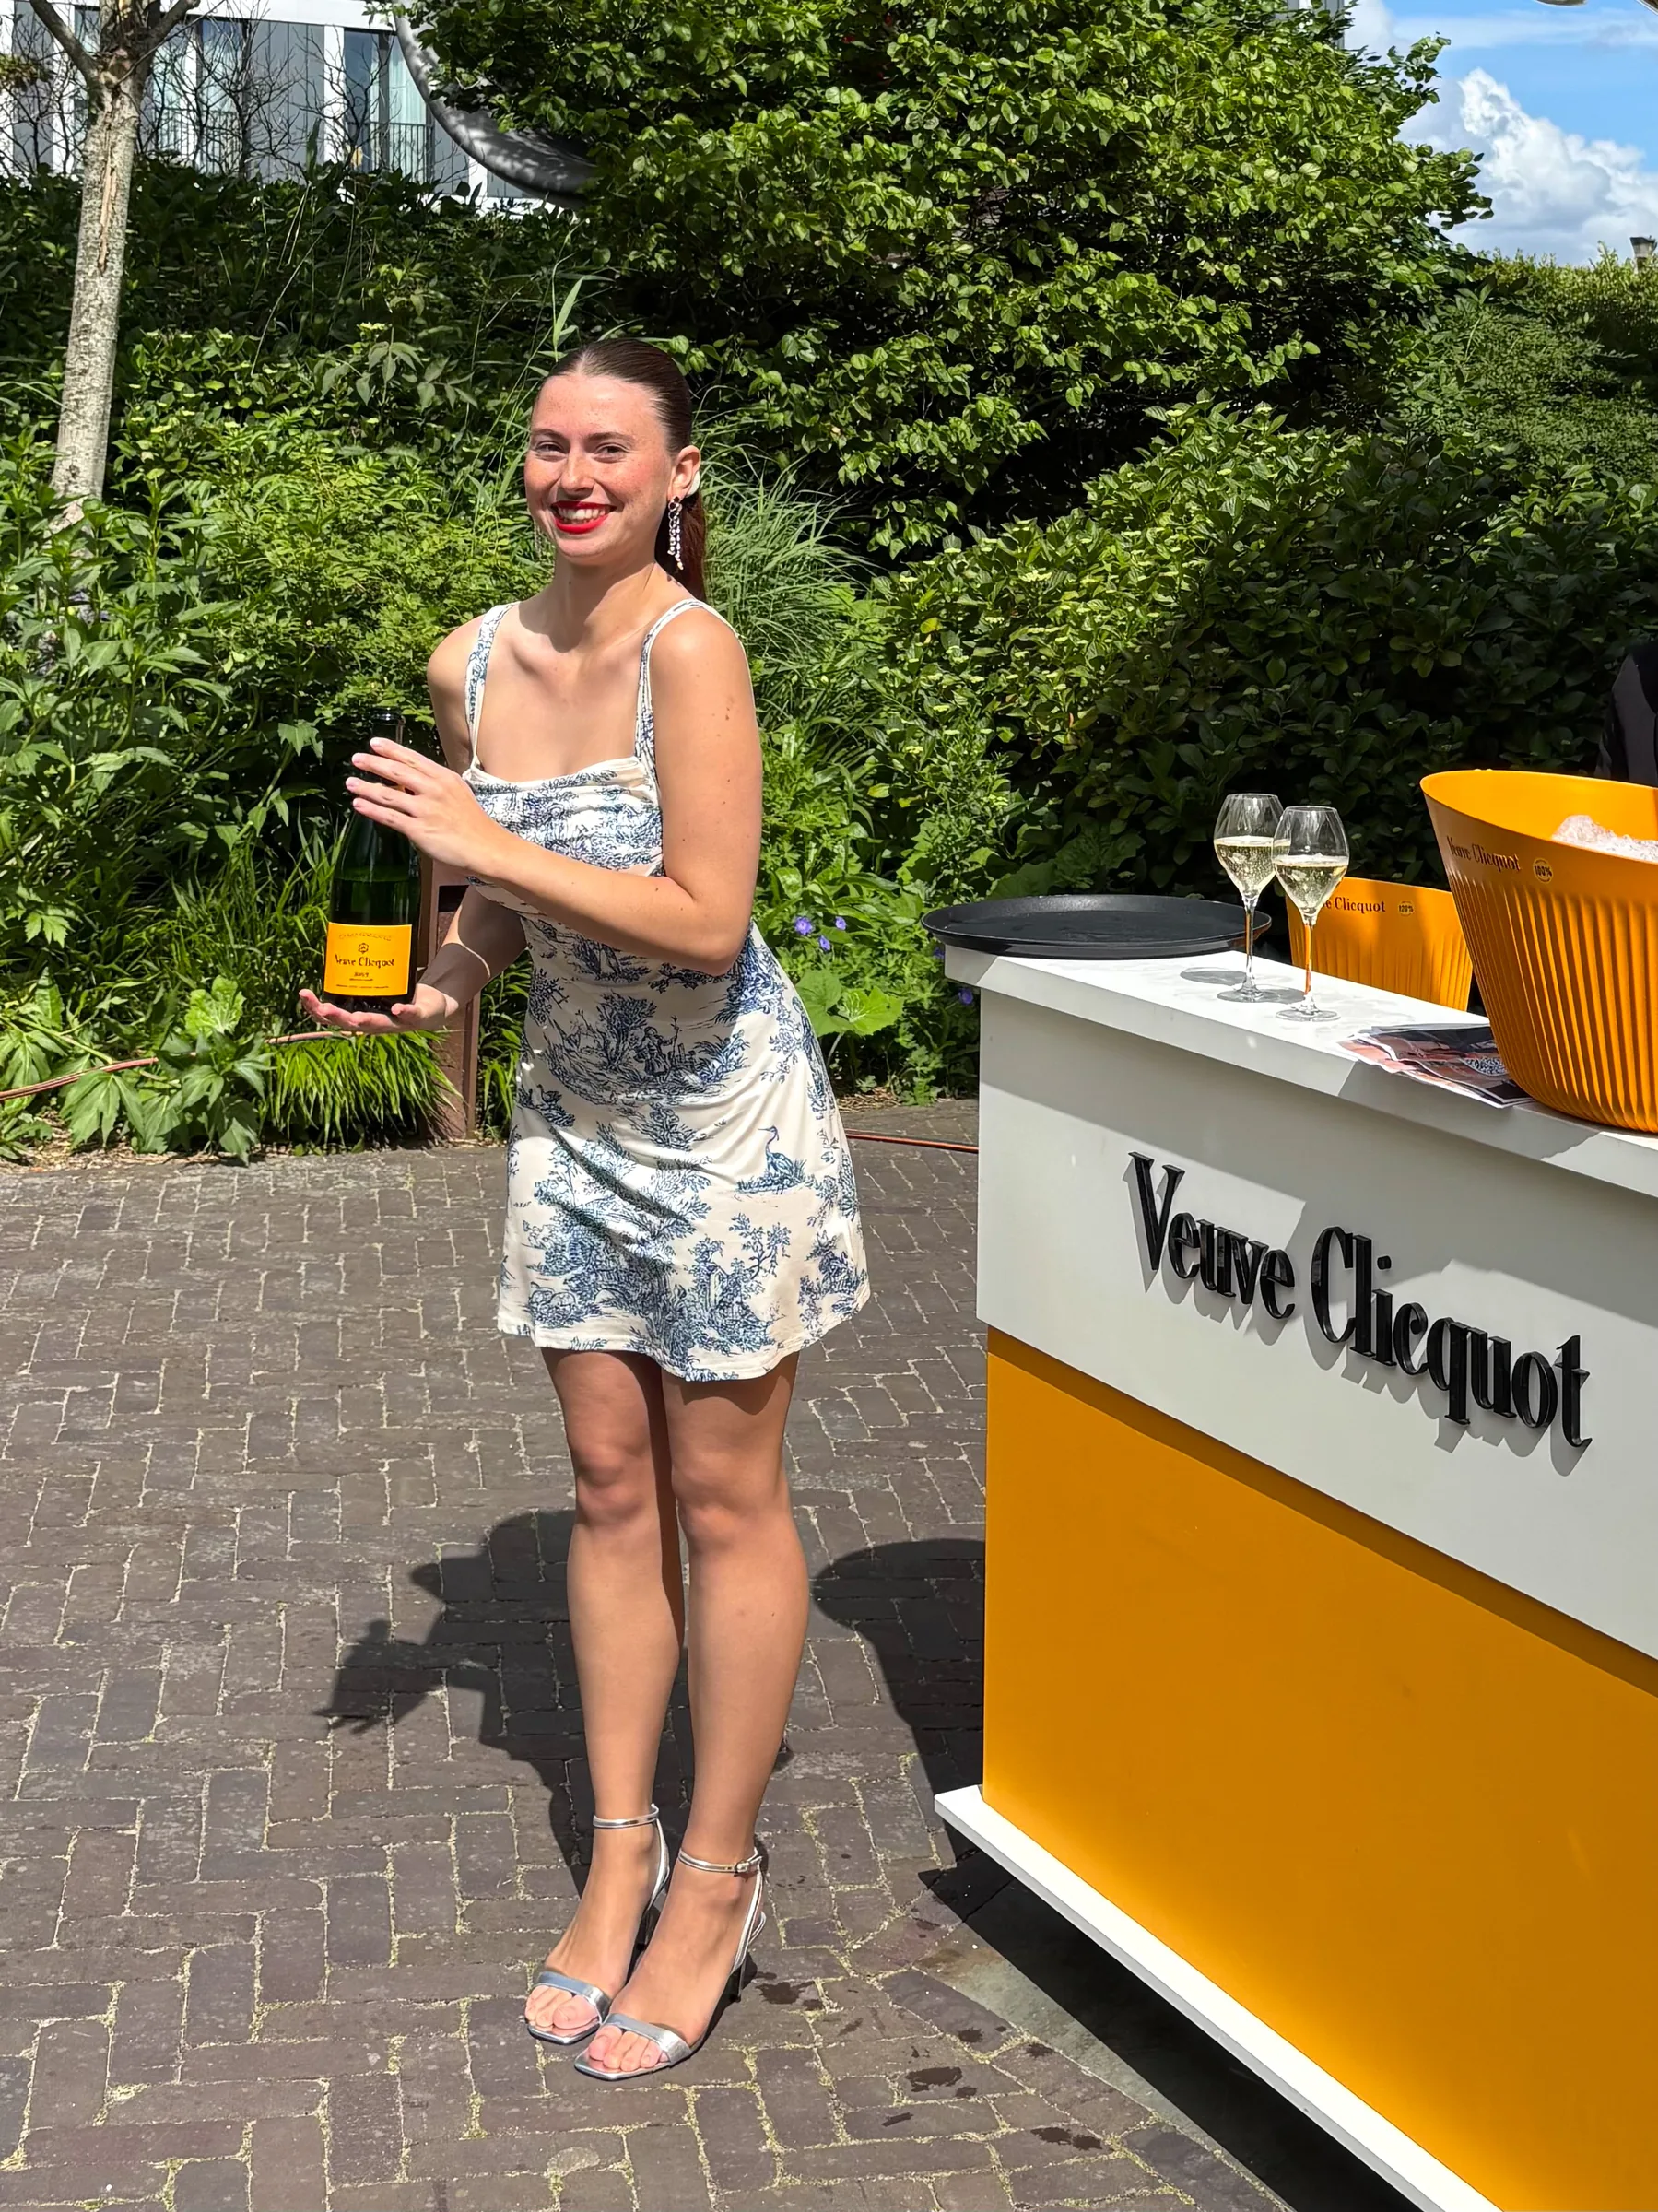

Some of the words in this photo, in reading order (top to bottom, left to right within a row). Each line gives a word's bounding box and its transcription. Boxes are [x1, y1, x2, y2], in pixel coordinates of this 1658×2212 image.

[1334, 896, 1385, 914] Clicquot
[1128, 1152, 1295, 1319] Veuve
[1311, 1227, 1593, 1448] Clicquot
